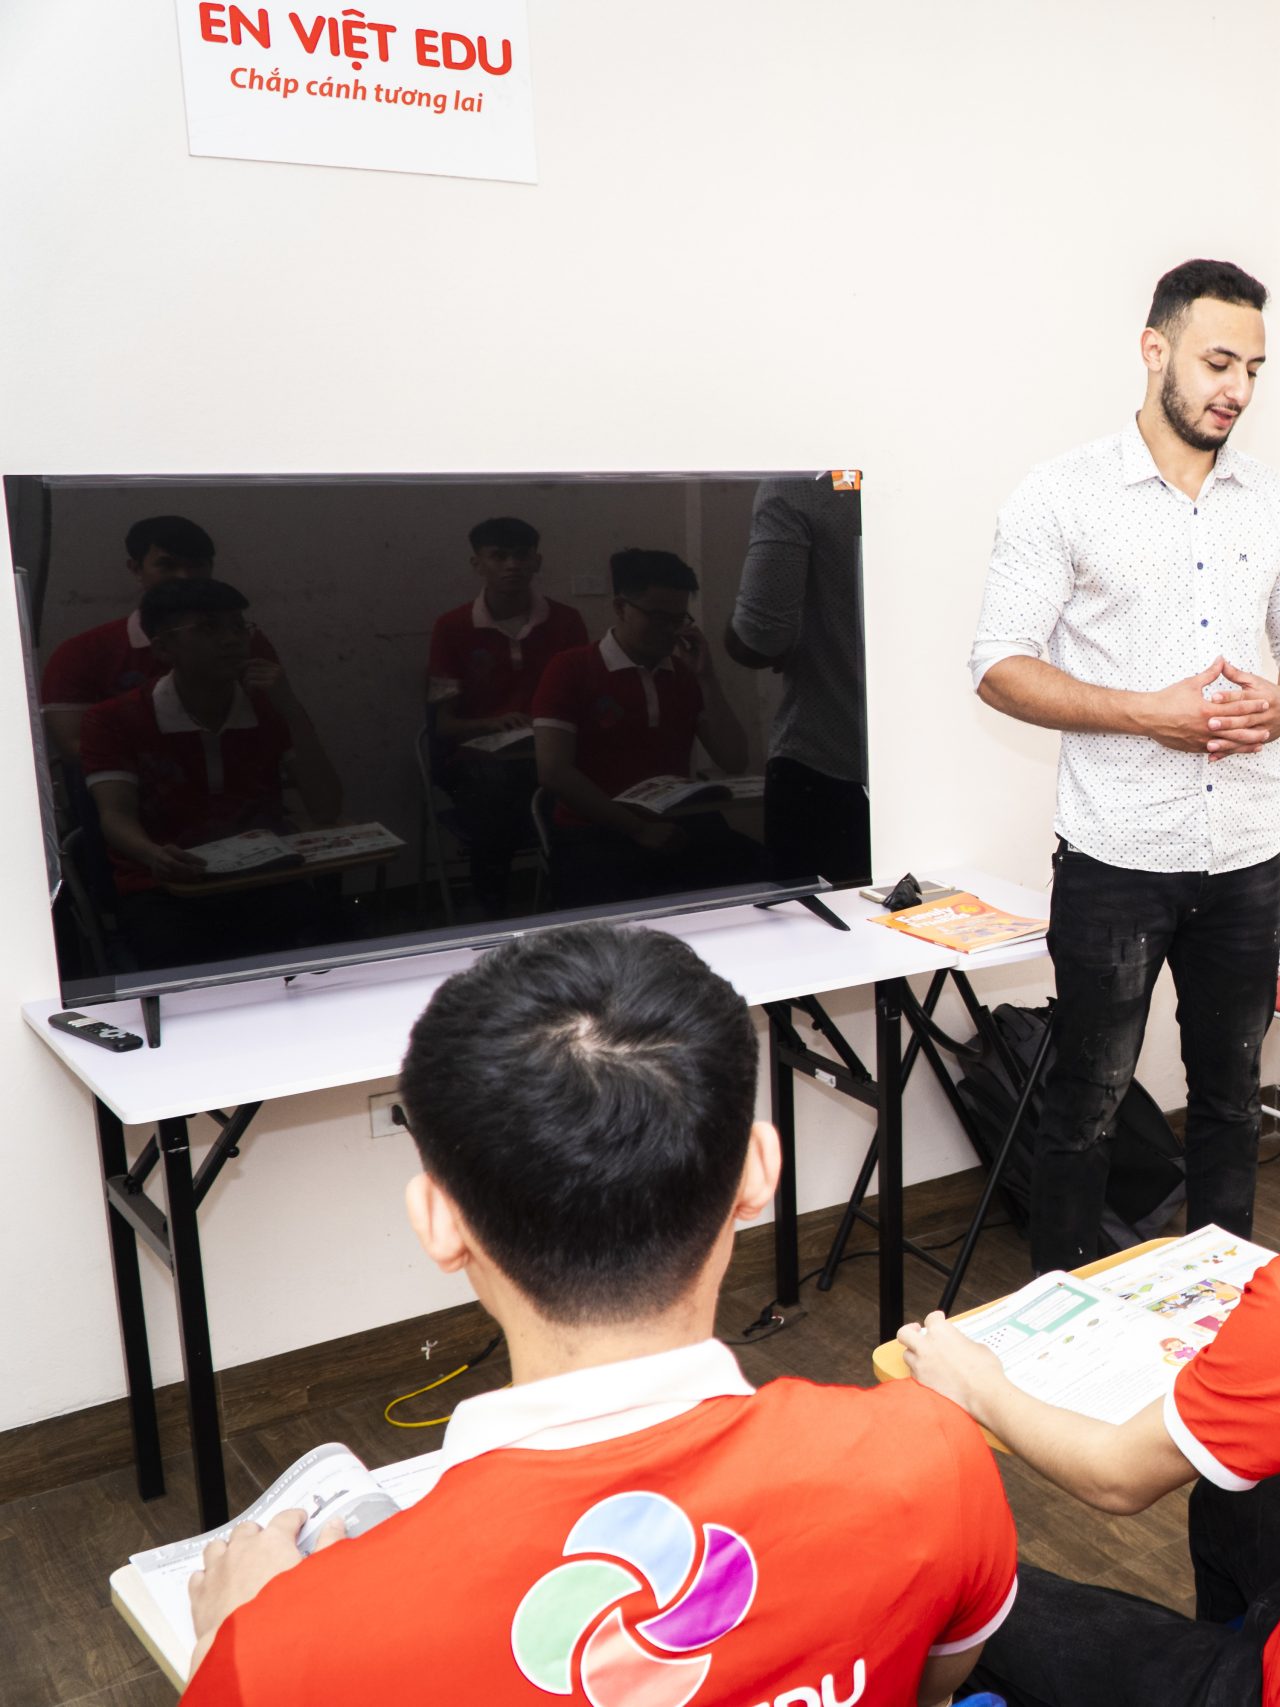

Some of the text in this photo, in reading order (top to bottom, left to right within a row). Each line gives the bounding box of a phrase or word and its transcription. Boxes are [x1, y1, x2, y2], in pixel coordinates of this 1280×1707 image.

[288, 9, 397, 71] VIỆT
[415, 28, 512, 76] EDU
[230, 67, 483, 114] Chắp cánh tương lai
